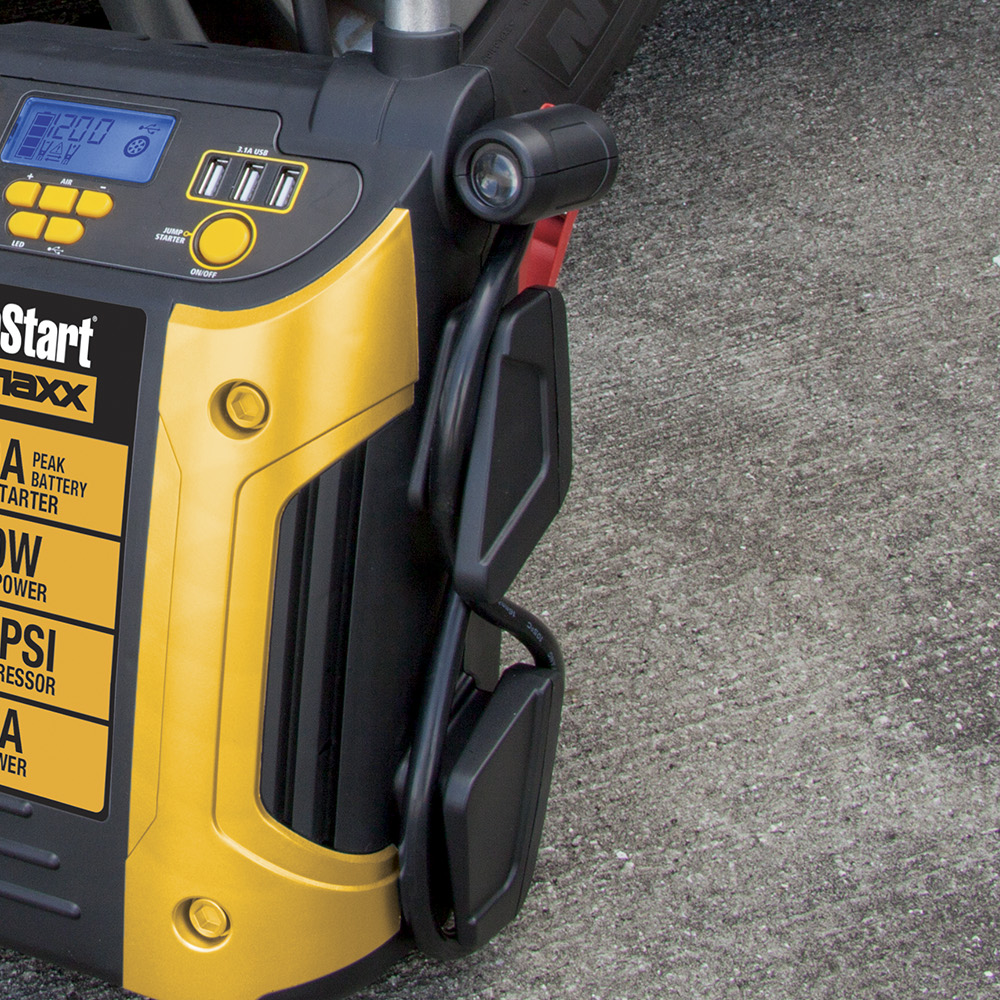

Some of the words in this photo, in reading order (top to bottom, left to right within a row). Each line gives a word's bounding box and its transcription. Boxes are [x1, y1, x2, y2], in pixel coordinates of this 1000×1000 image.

[47, 112, 116, 147] 1200
[236, 145, 252, 155] 3.1A
[253, 148, 269, 157] USB
[60, 177, 73, 186] AIR
[163, 227, 184, 238] JUMP
[11, 240, 26, 249] LED
[155, 233, 186, 245] STARTER
[189, 267, 218, 280] ON/OFF
[32, 451, 65, 473] PEAK
[31, 472, 88, 499] BATTERY
[0, 617, 56, 673] PSI
